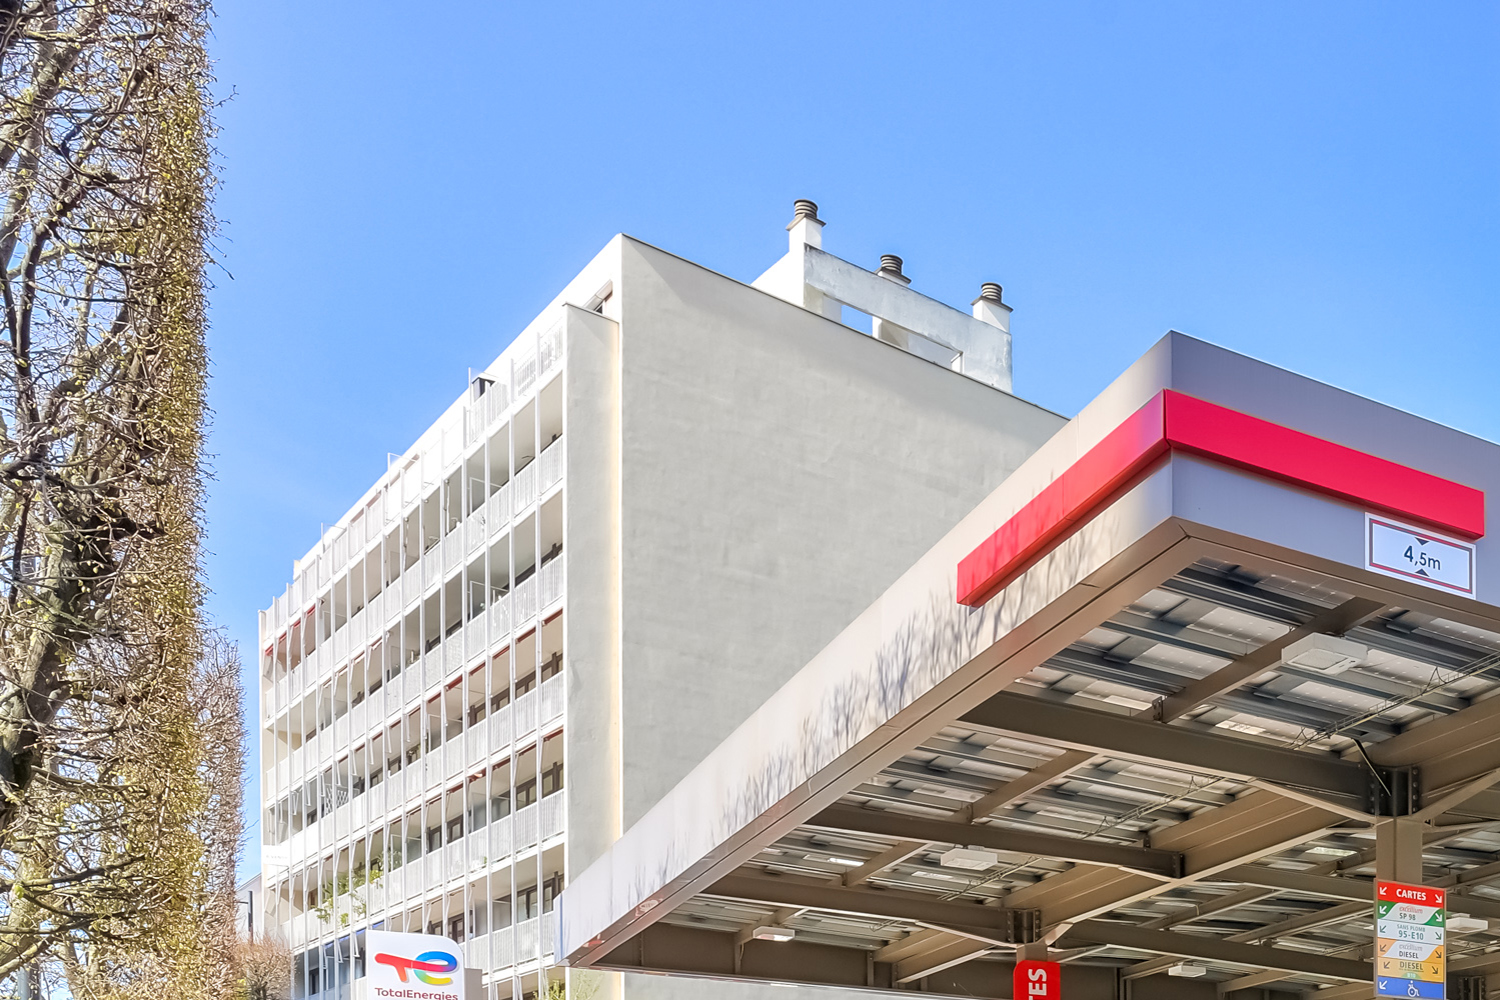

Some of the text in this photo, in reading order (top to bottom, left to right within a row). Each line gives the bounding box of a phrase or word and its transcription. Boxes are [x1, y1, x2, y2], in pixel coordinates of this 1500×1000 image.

[1404, 545, 1441, 570] 4,5m
[1396, 888, 1427, 901] CARTES
[1410, 925, 1426, 933] PLOMB
[1398, 930, 1424, 941] 95-E10
[1399, 951, 1419, 959] DIESEL
[1400, 961, 1424, 971] DIESEL
